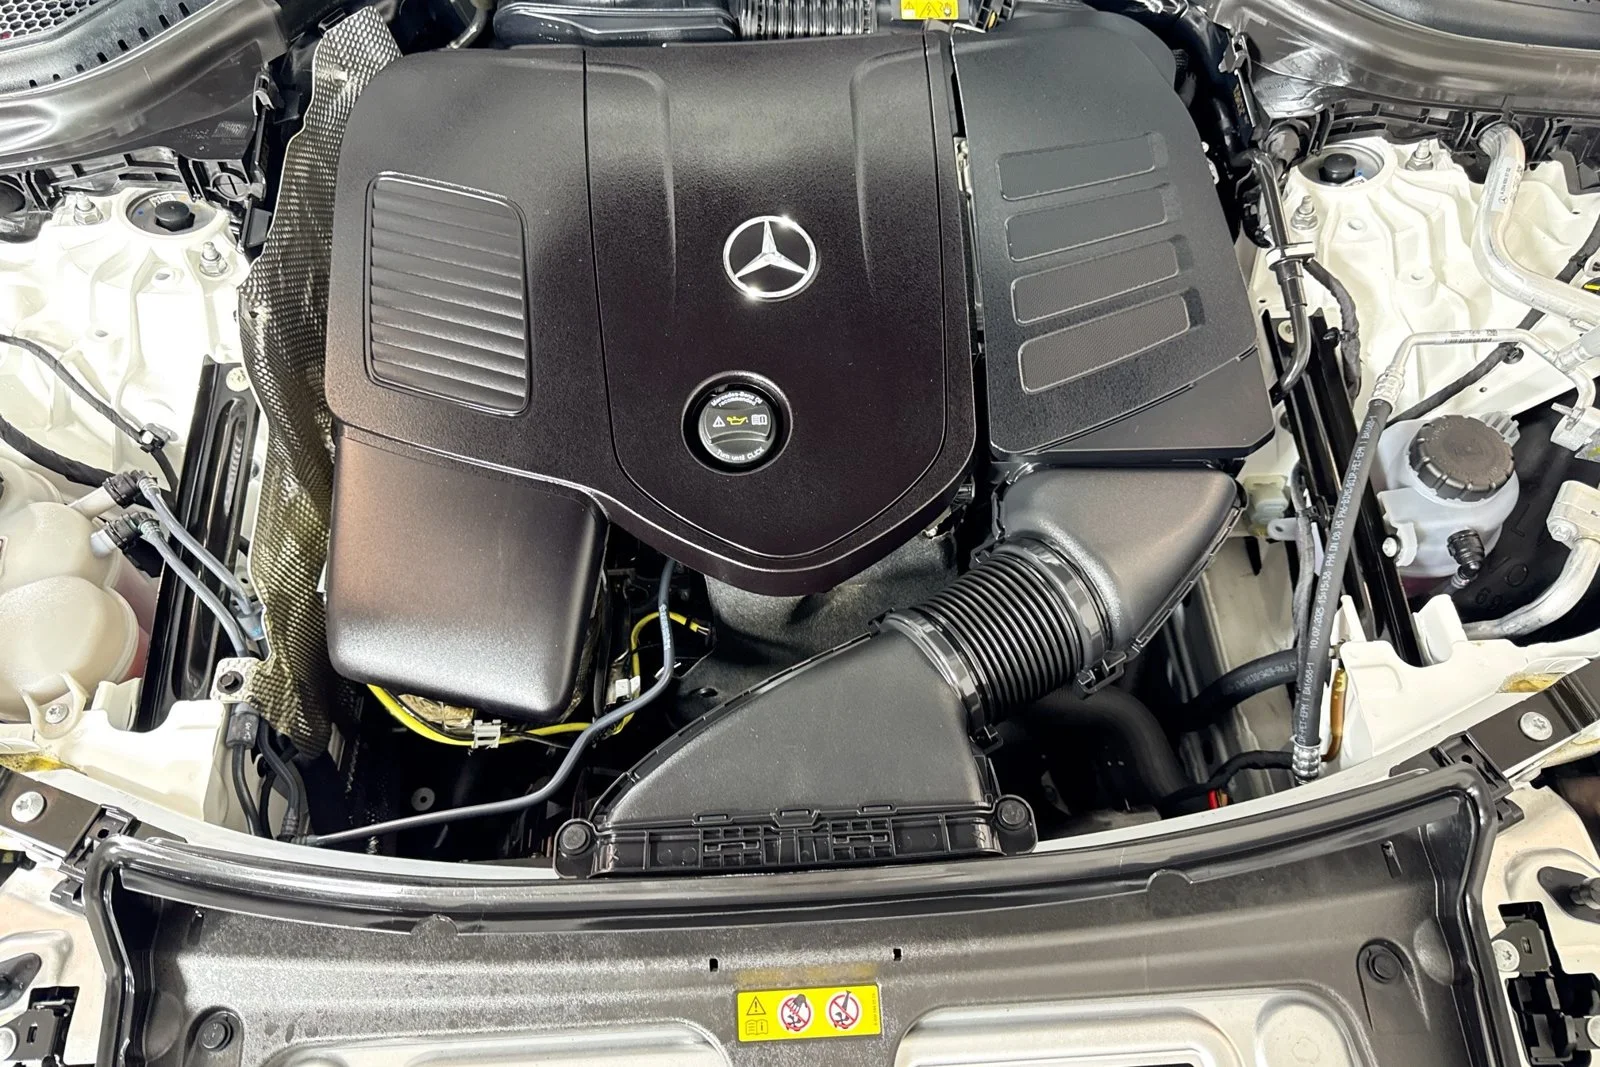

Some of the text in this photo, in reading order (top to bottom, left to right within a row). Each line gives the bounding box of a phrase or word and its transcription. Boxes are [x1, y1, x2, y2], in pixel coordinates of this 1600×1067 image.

[711, 392, 755, 406] Mercedes-Benz
[718, 396, 756, 408] recommended
[717, 449, 730, 460] Turn
[747, 446, 764, 460] CLICK
